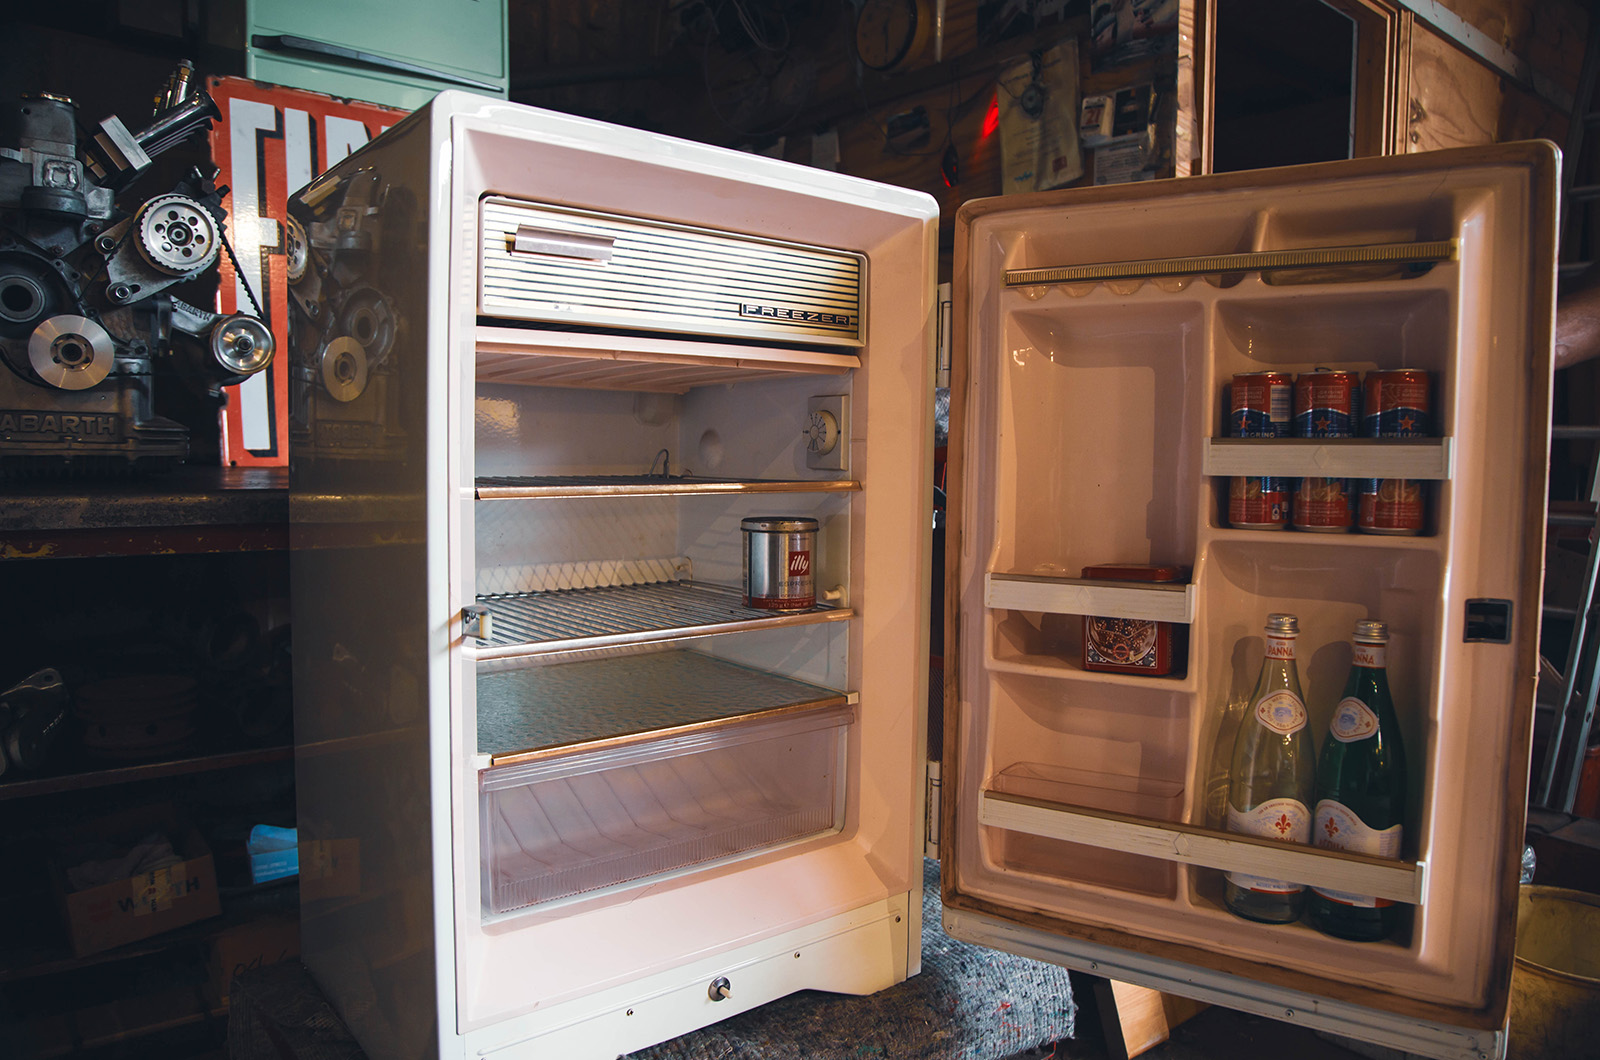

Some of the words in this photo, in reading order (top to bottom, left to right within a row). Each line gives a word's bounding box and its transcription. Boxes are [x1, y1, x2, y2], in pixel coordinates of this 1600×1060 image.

[176, 300, 212, 321] ABARTH
[744, 303, 849, 325] FREEZER
[0, 413, 116, 436] ABARTH
[790, 554, 809, 574] illy
[1267, 645, 1293, 657] PANNA
[1353, 653, 1375, 665] ANNA
